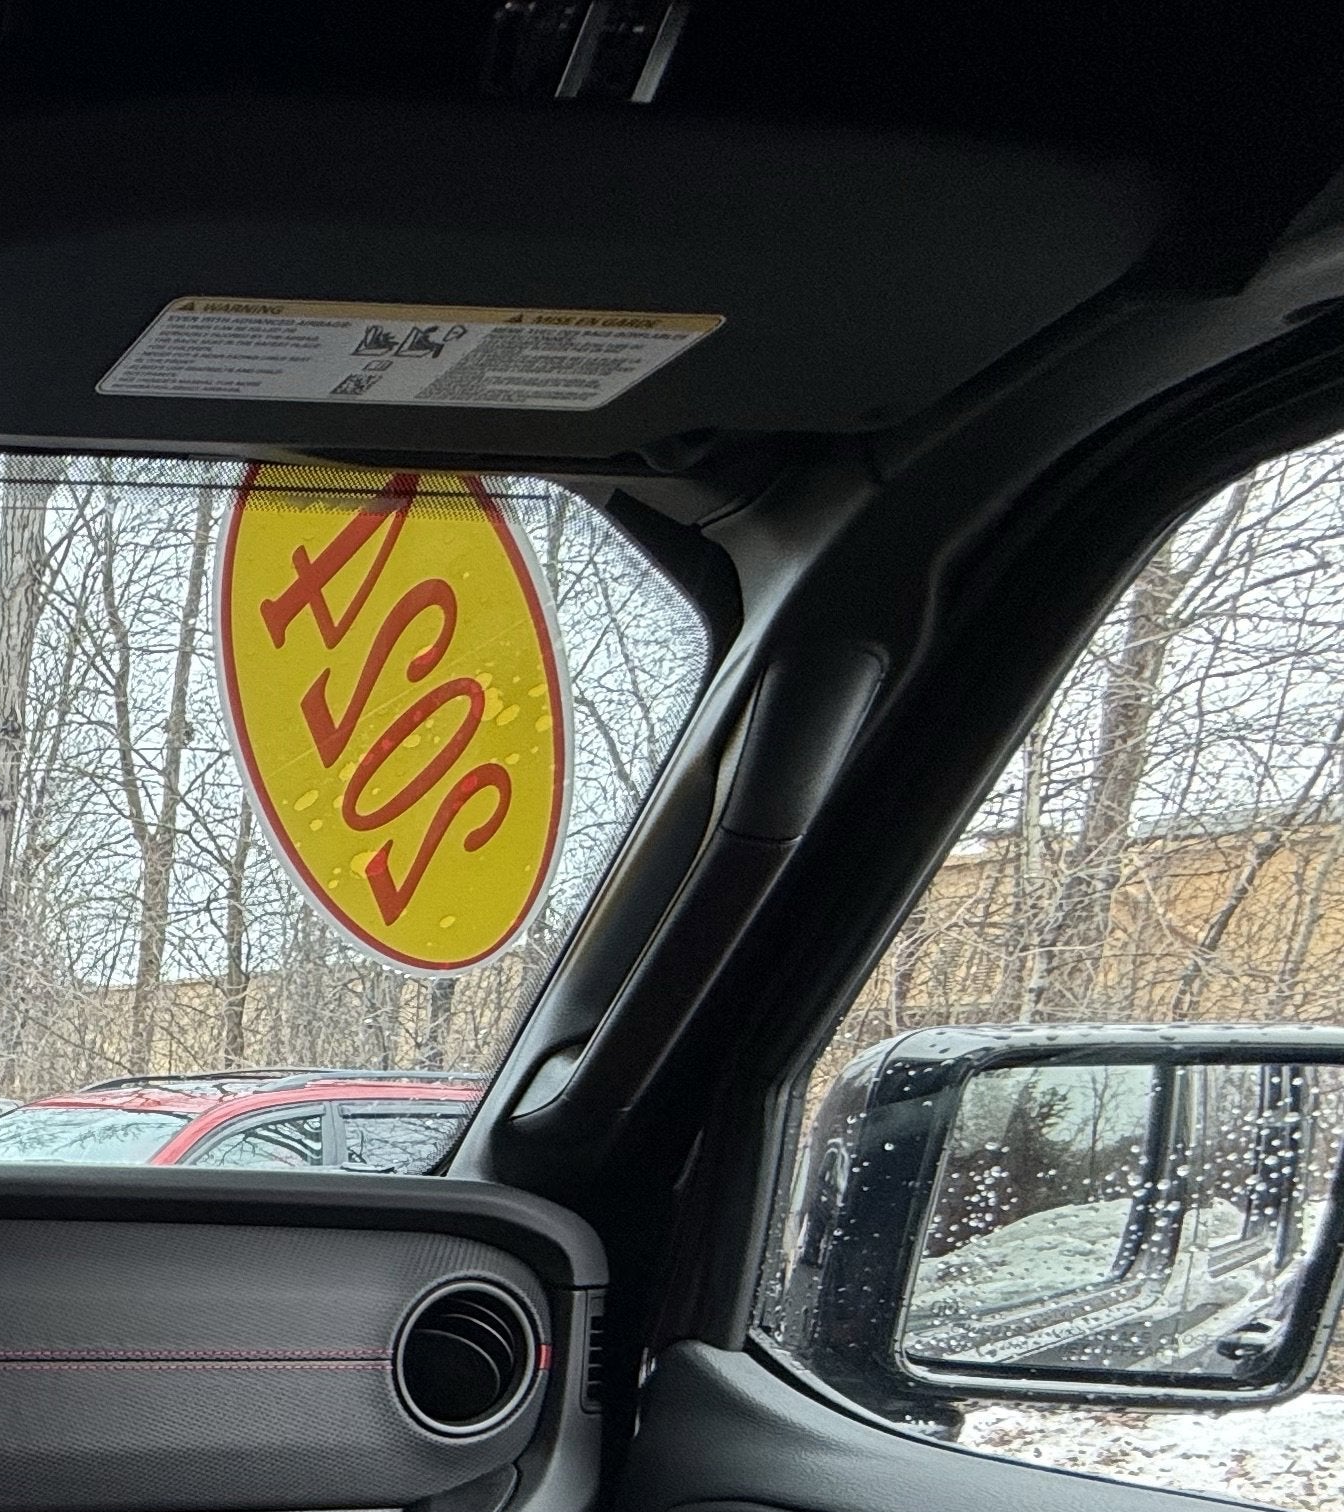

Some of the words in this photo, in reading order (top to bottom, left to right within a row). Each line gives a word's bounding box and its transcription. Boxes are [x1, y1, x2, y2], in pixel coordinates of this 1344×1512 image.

[203, 303, 286, 315] WARNING
[532, 315, 571, 325] MISE
[576, 317, 600, 326] EN
[601, 318, 659, 328] GARDE
